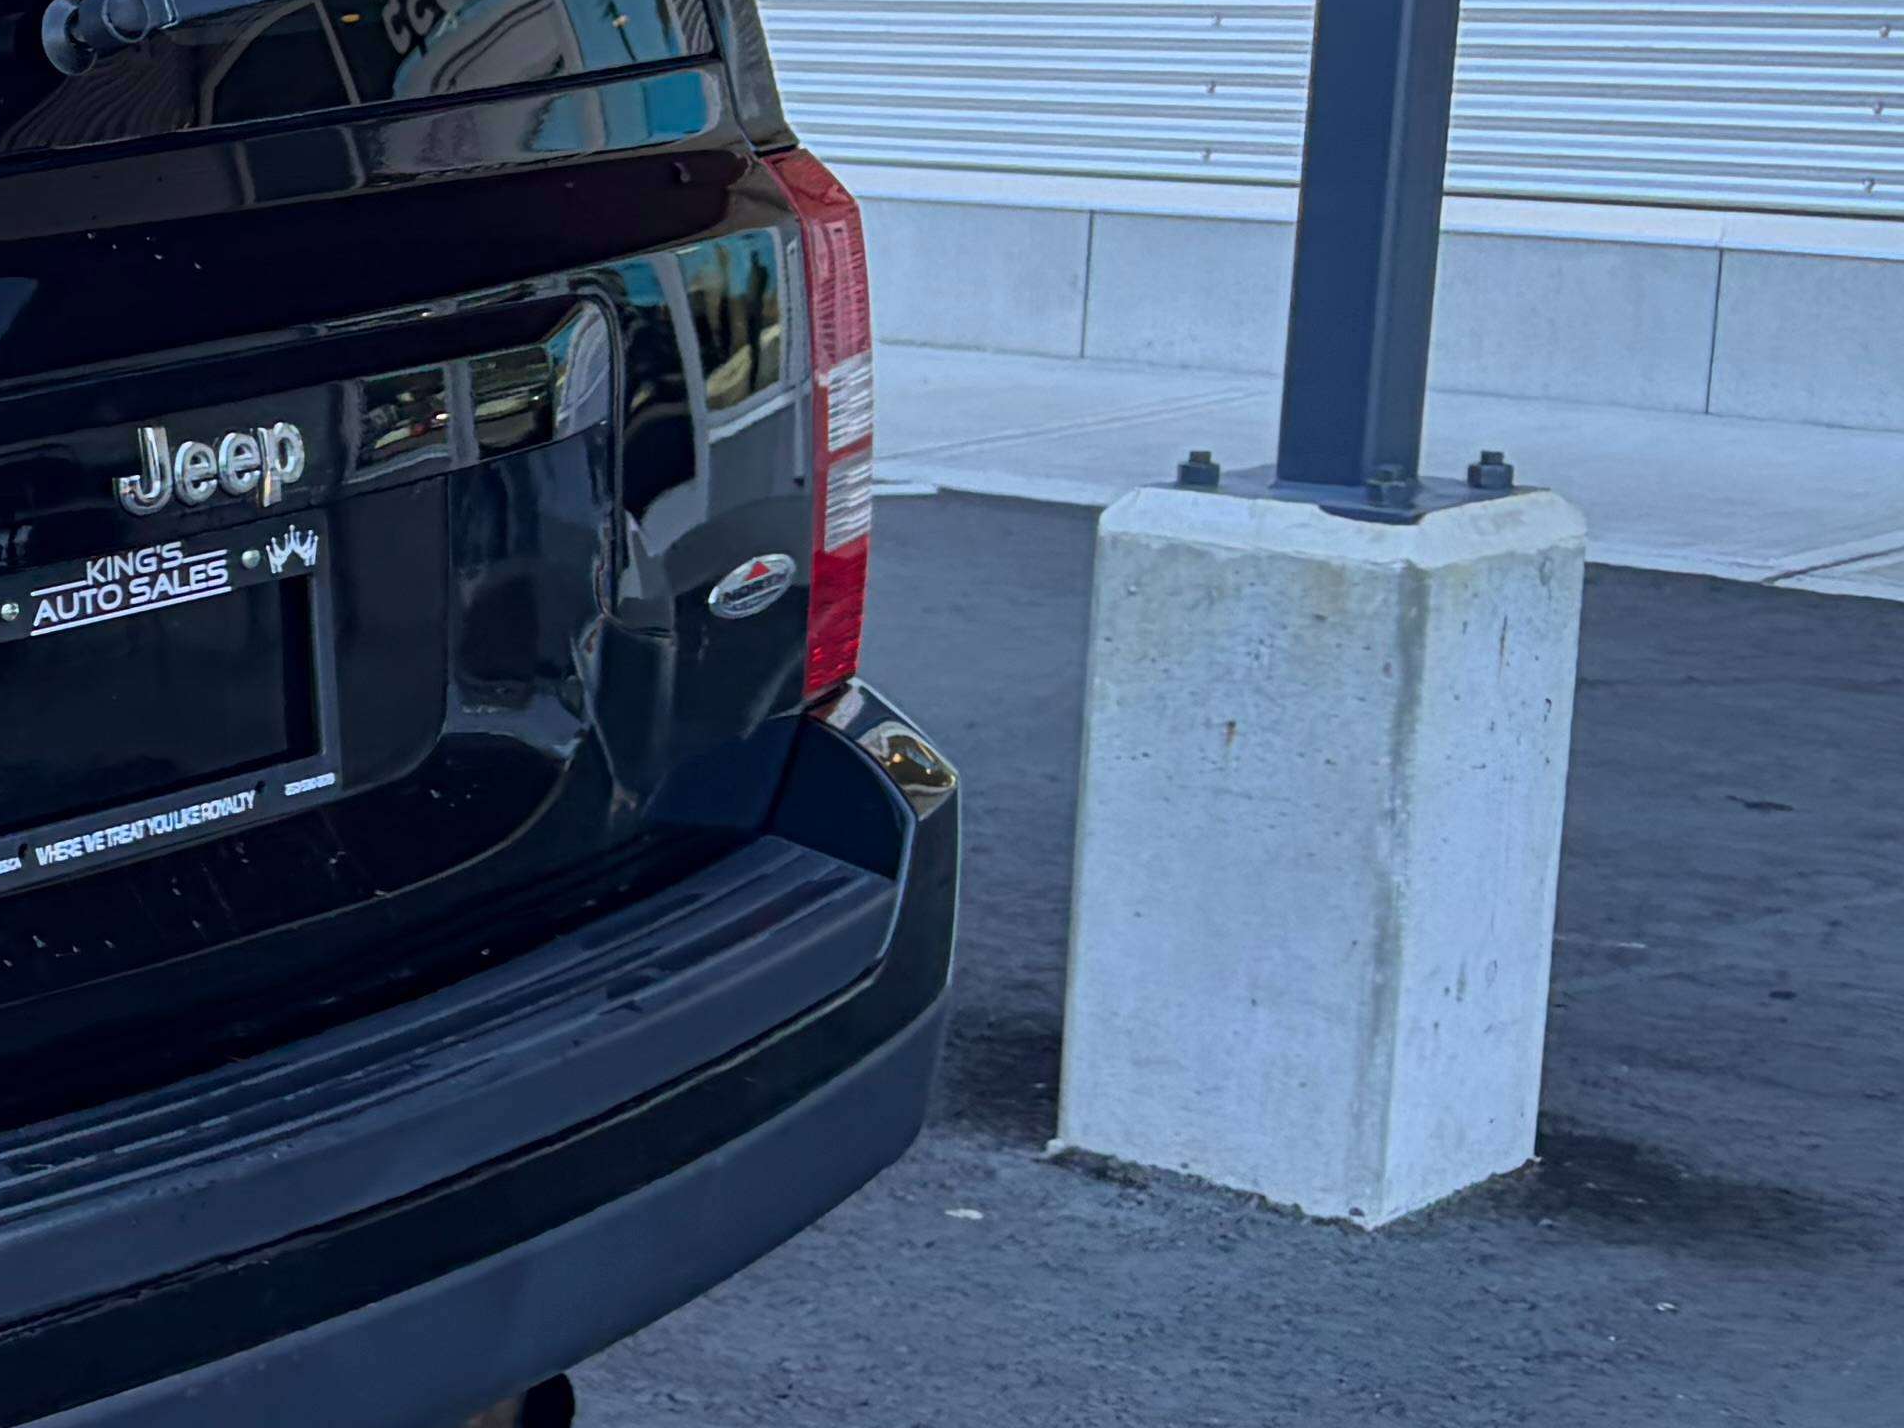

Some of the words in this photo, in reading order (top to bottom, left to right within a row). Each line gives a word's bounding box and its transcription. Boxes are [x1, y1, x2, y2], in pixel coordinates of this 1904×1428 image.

[113, 421, 305, 516] Jeep
[33, 580, 123, 627] AUTO
[128, 560, 229, 604] SALES
[85, 541, 184, 584] KING'S
[35, 836, 84, 866] WHERE
[83, 830, 106, 853] WE
[105, 820, 145, 848] TREAT
[144, 814, 174, 837] YOU
[173, 804, 202, 829] LIKE
[201, 789, 256, 822] ROYALTY
